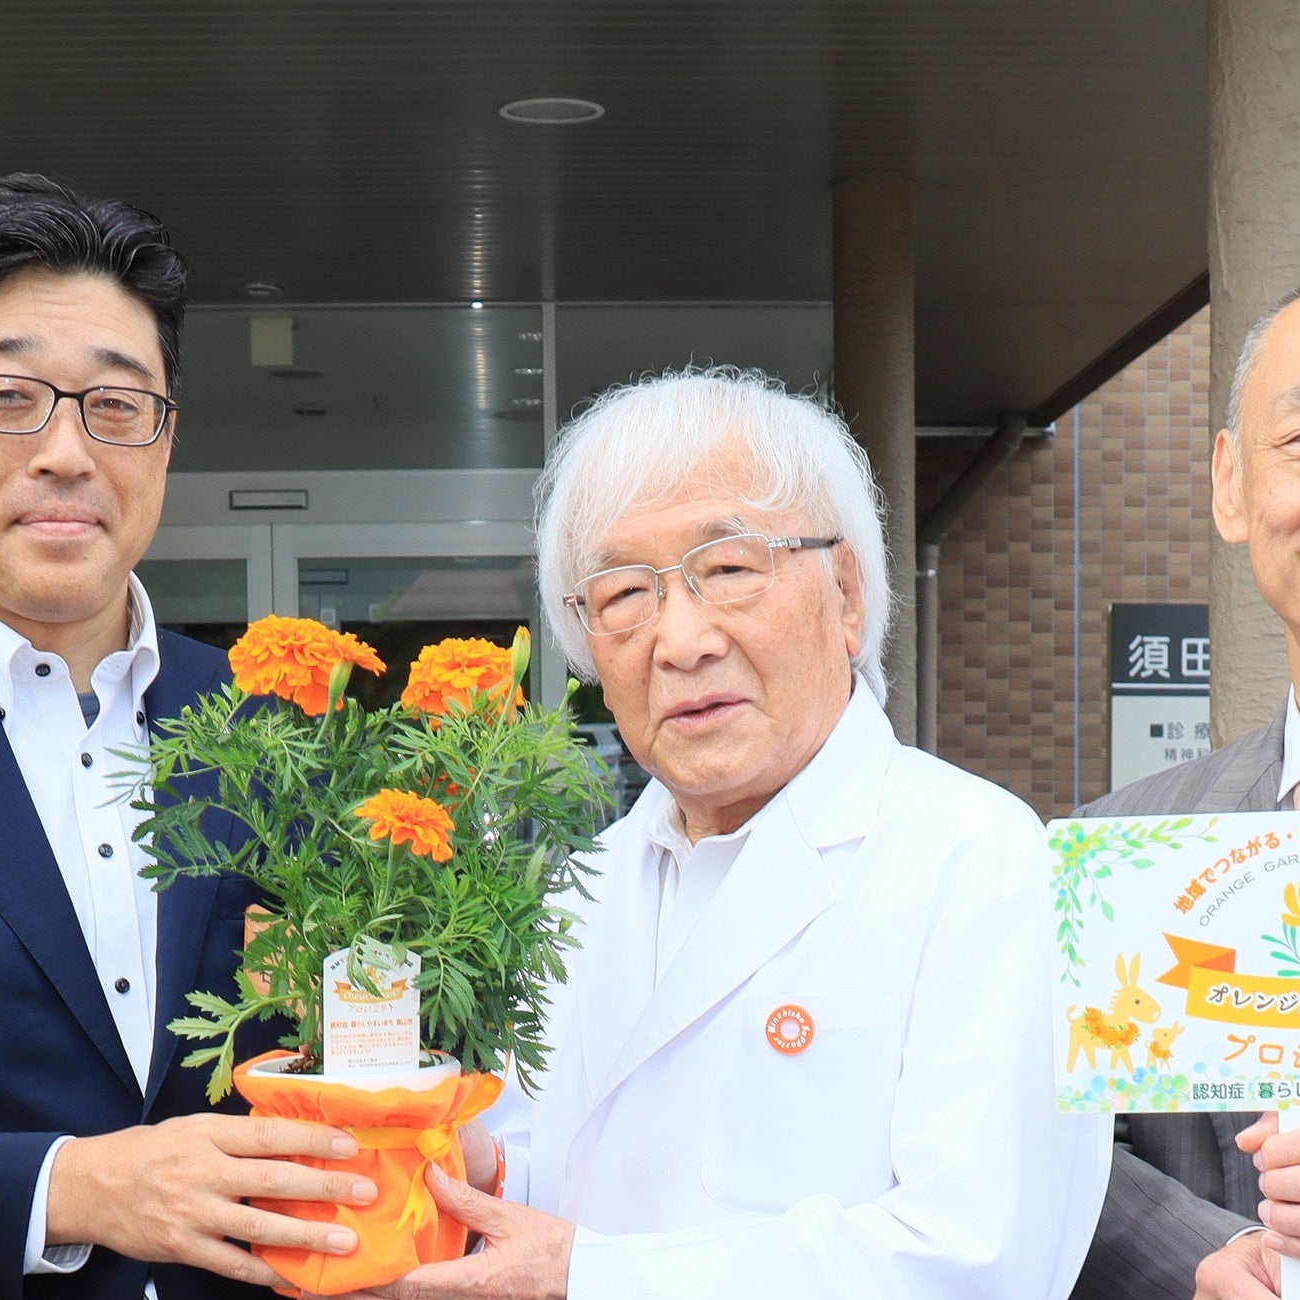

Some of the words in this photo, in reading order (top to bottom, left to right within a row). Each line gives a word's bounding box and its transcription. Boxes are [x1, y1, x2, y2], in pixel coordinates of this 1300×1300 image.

[1128, 634, 1211, 678] 須田
[1199, 871, 1256, 928] ORANGE
[1192, 1082, 1246, 1100] 認知症
